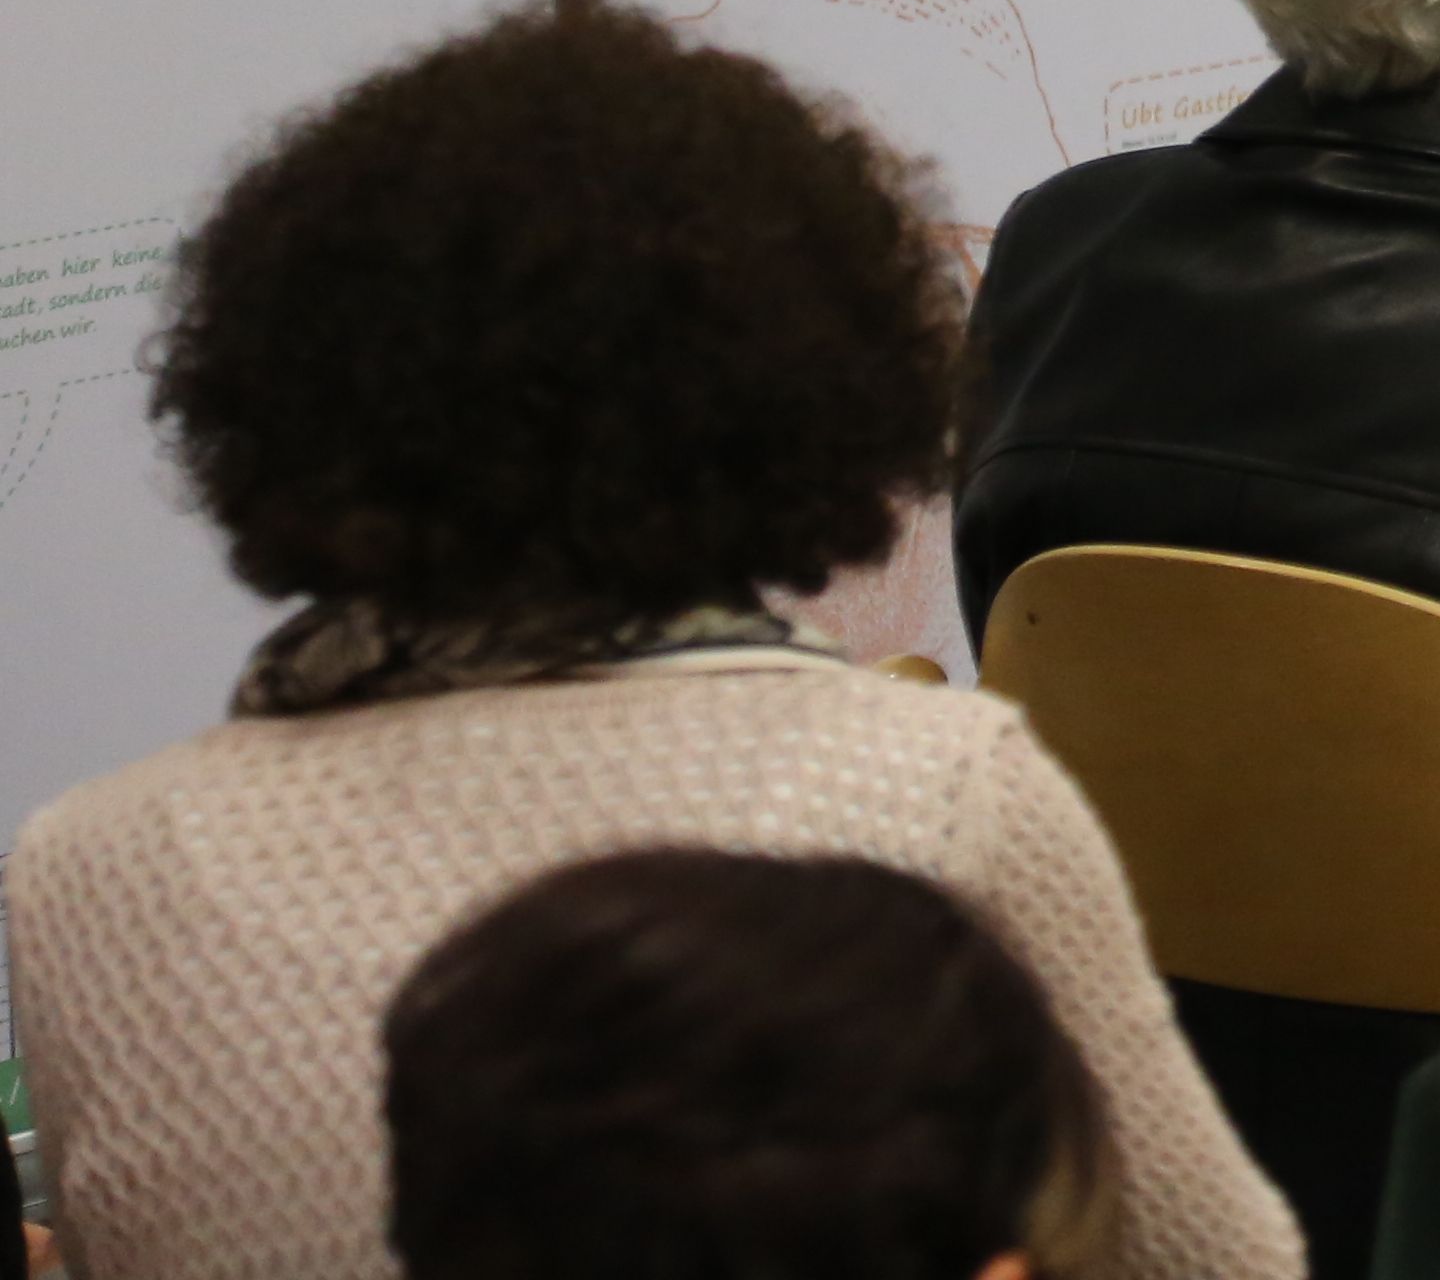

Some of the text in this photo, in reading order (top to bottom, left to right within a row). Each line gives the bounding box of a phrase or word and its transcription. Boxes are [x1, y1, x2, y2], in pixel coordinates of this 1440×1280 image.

[61, 255, 100, 277] hier
[111, 246, 163, 268] keine
[49, 284, 126, 310] sondern
